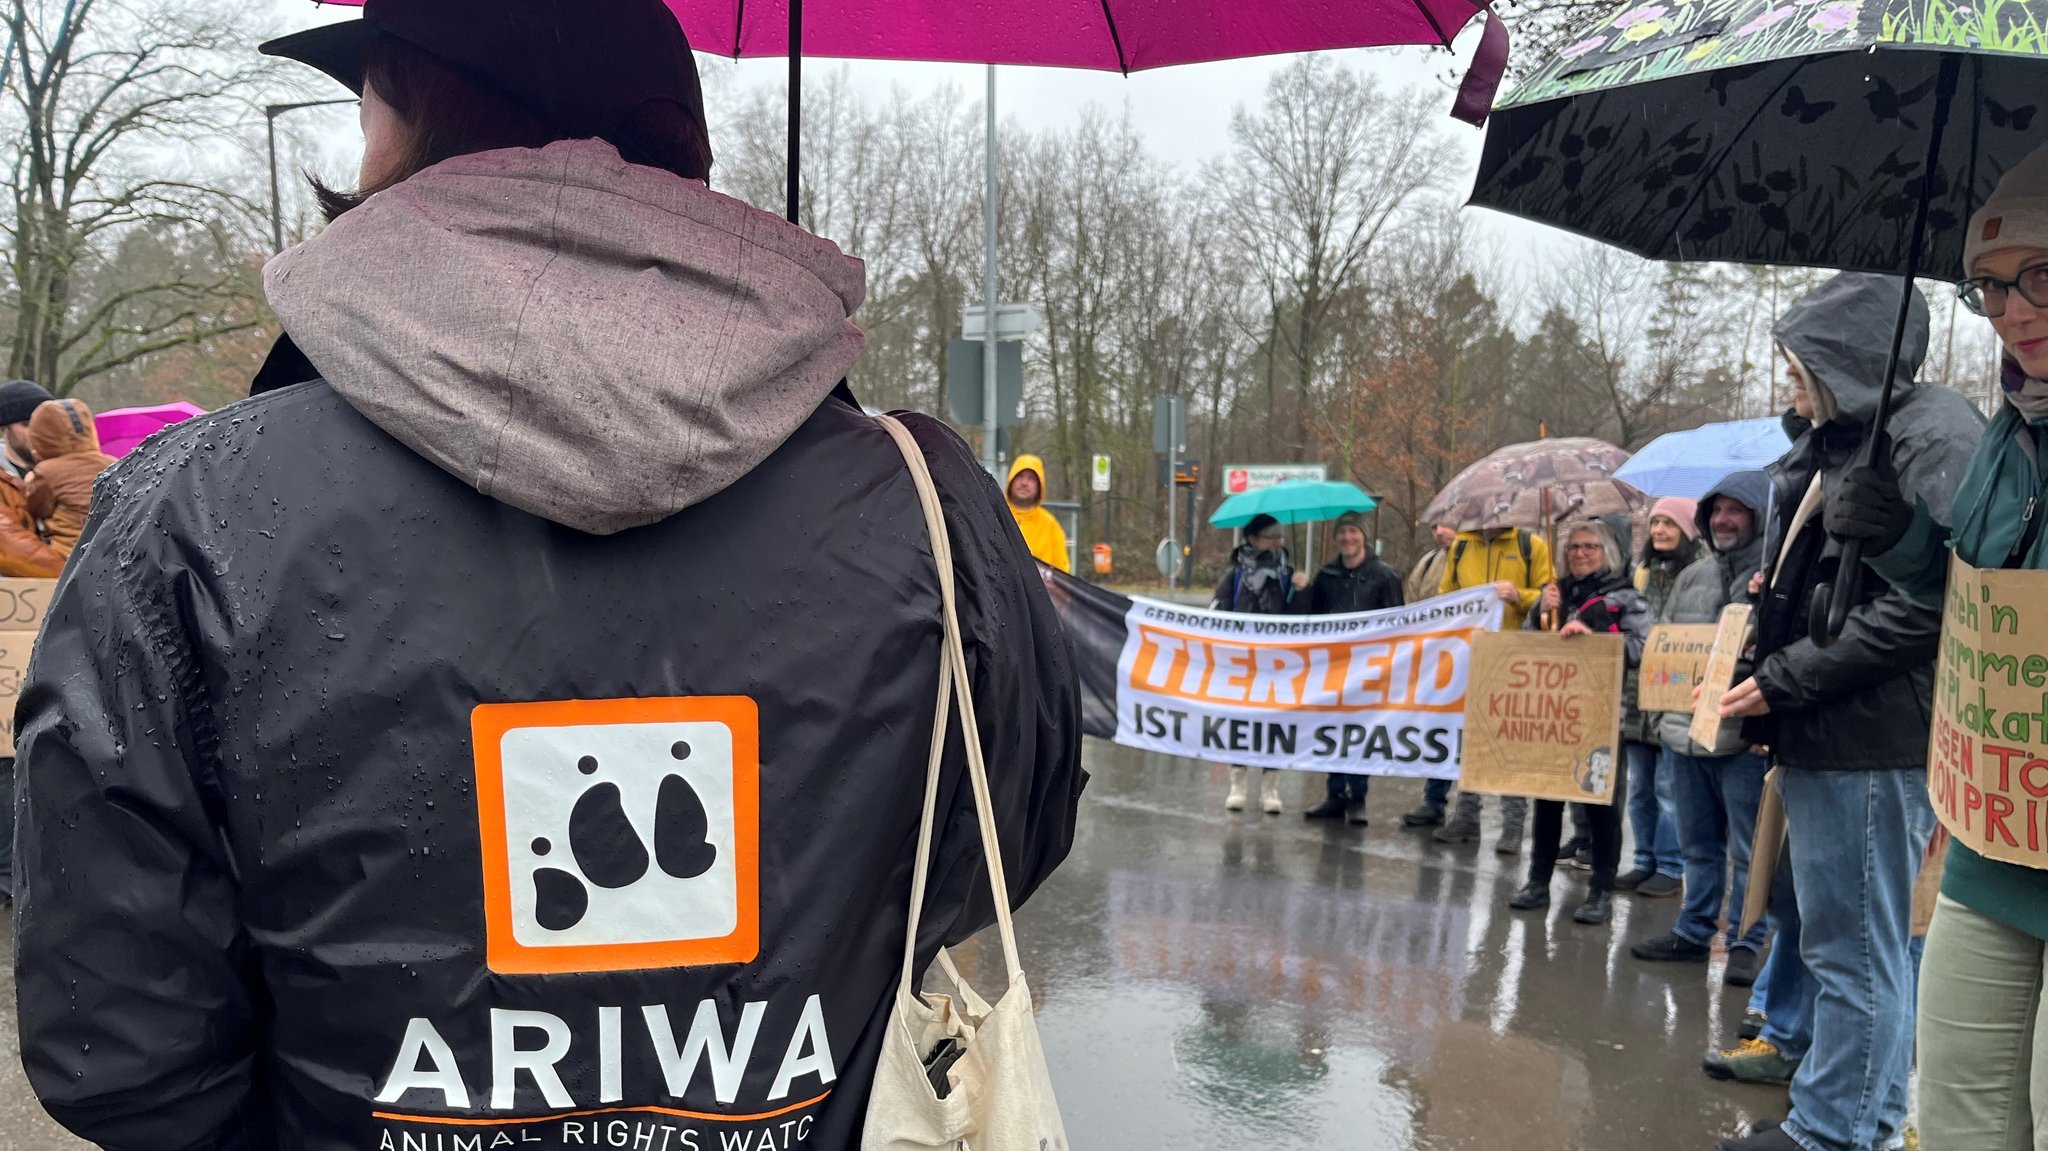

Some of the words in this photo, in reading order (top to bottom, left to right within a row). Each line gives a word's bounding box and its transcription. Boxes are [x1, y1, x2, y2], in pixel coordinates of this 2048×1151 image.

[1143, 634, 1469, 706] TIERLEID
[1507, 660, 1578, 690] STOP
[1488, 692, 1580, 722] KILLING
[1135, 703, 1188, 742] IST
[1202, 714, 1297, 754] KEIN
[1496, 719, 1581, 746] ANIMALS
[1964, 781, 2048, 853] PRI
[373, 994, 837, 1109] ARIWA
[380, 1128, 541, 1151] ANIMAL
[563, 1119, 699, 1151] RIGHTS
